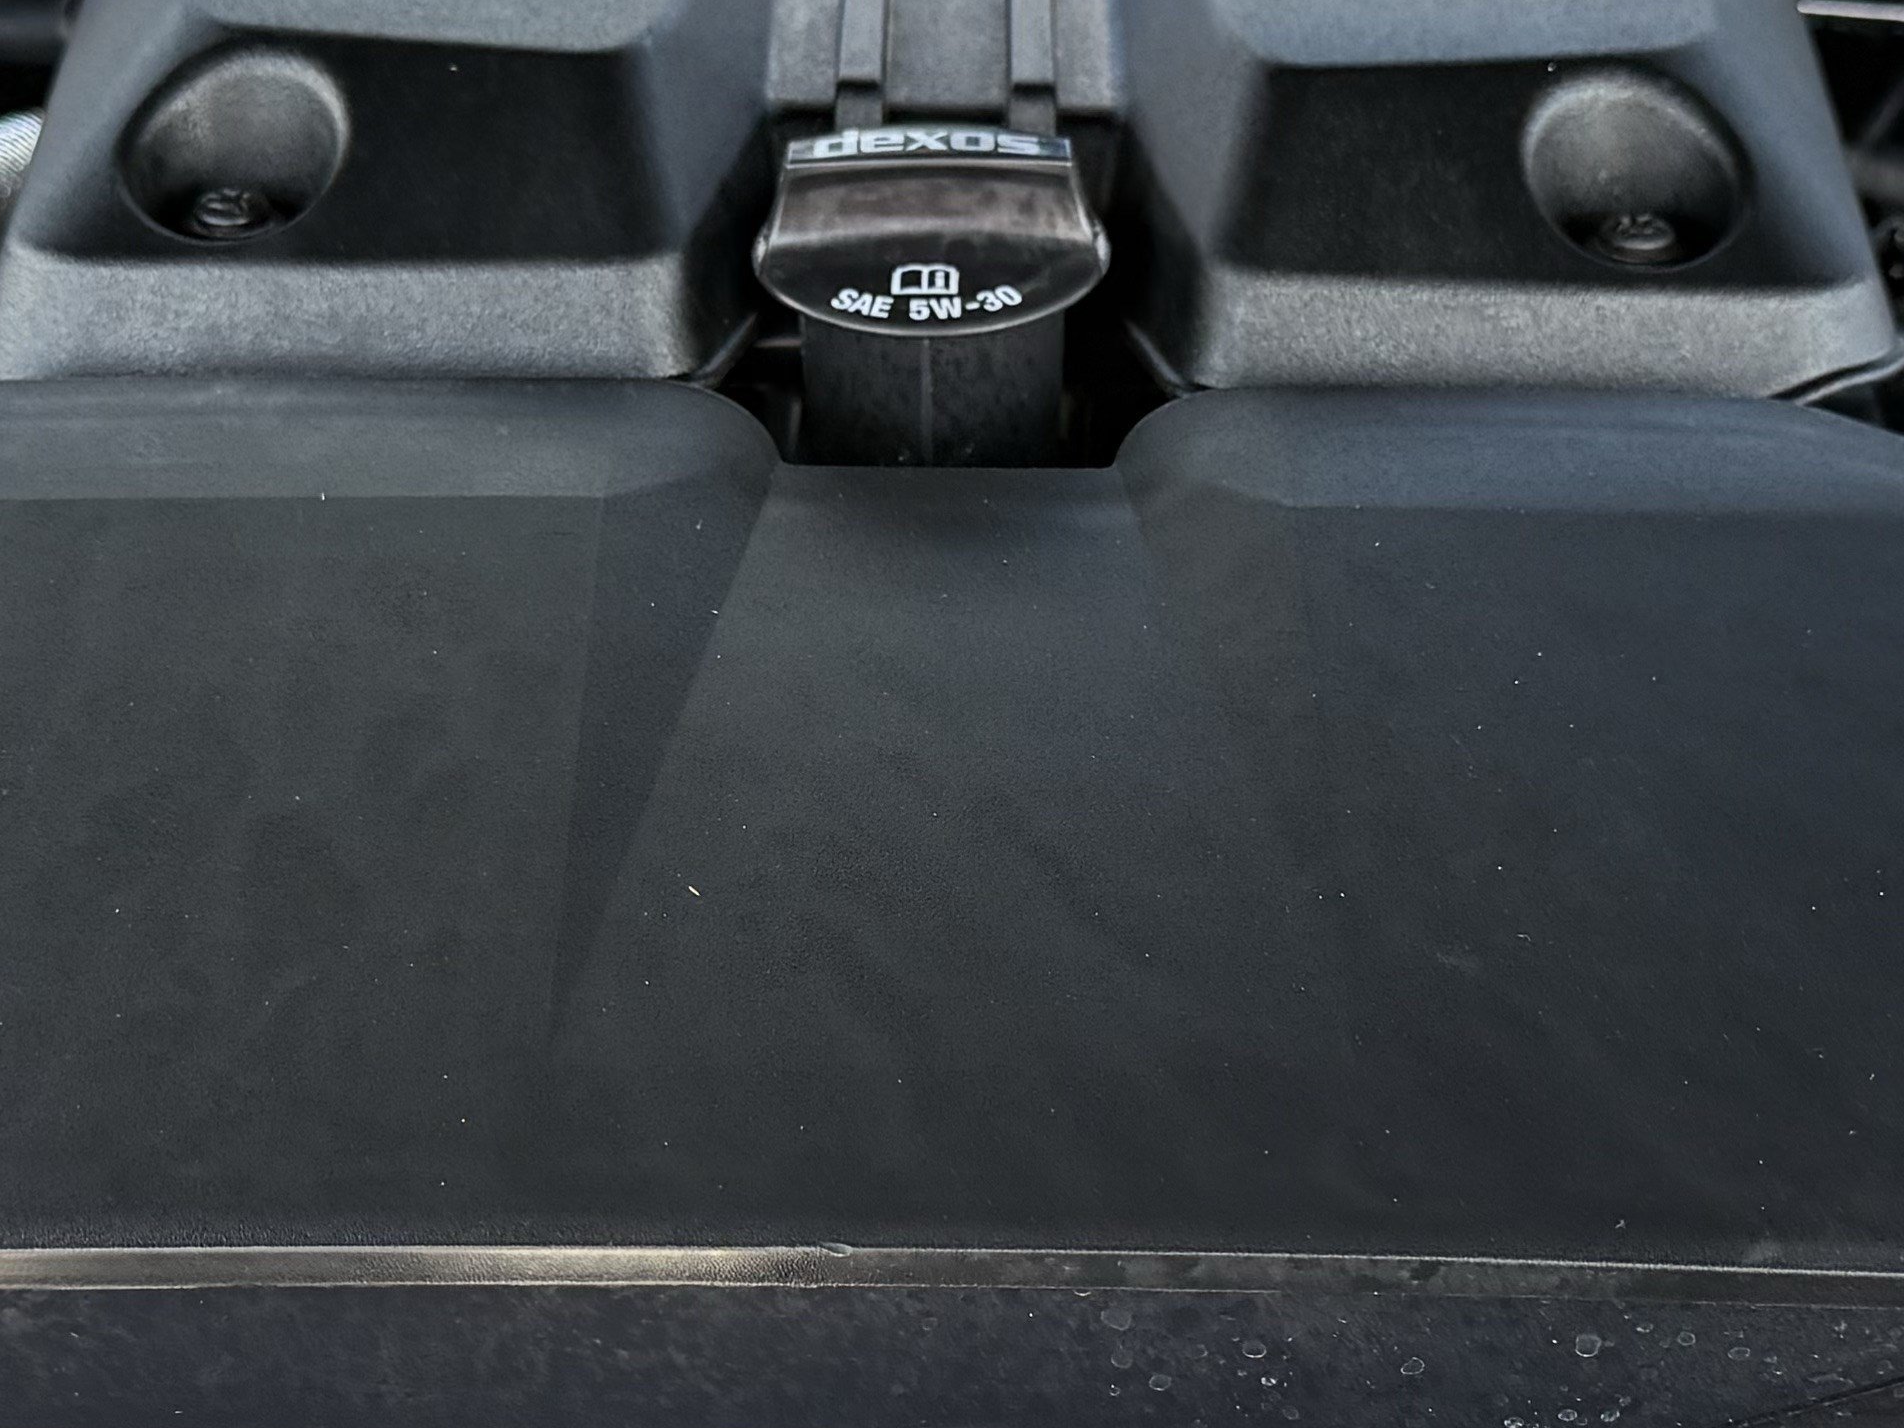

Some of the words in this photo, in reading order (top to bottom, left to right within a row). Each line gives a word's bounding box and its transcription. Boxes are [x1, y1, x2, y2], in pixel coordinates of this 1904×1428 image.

[813, 129, 1040, 158] dexos
[831, 288, 894, 319] SAE
[909, 286, 1023, 321] 5W-30
